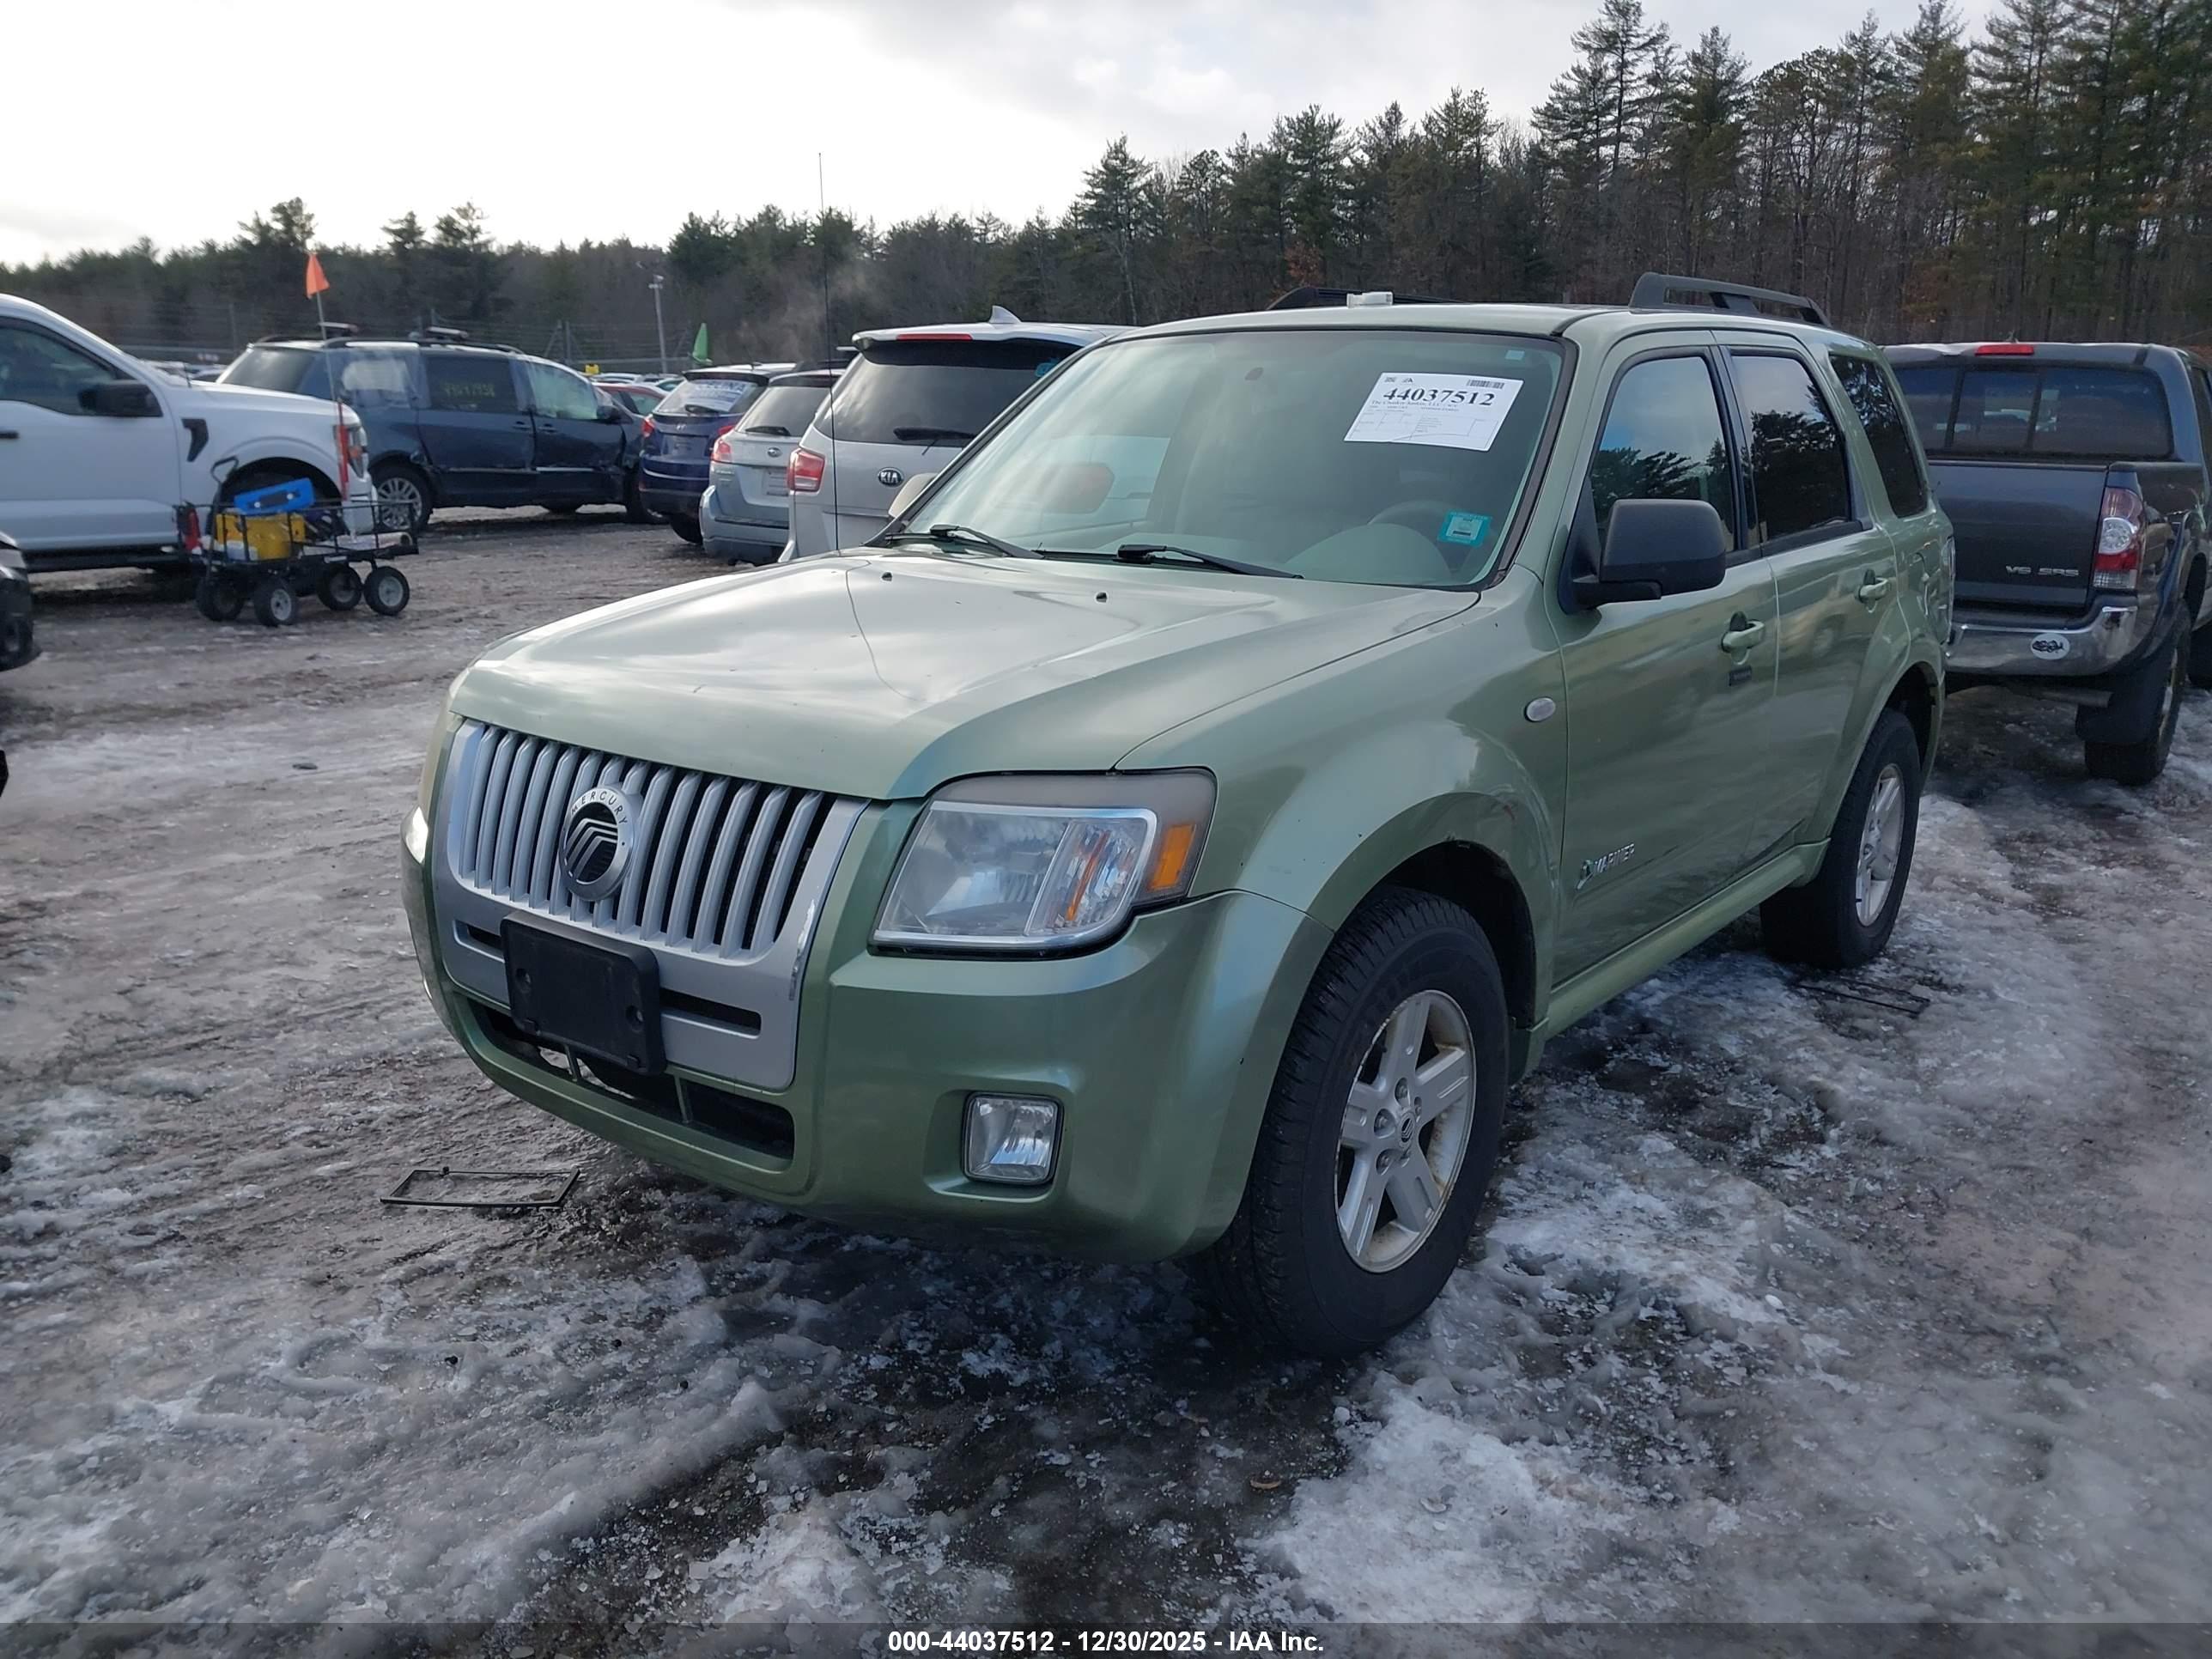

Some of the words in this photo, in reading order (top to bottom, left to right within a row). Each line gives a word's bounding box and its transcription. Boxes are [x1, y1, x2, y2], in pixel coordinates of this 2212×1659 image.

[1382, 387, 1495, 406] 44037512
[880, 471, 899, 483] KIA
[571, 791, 628, 824] MERCURY
